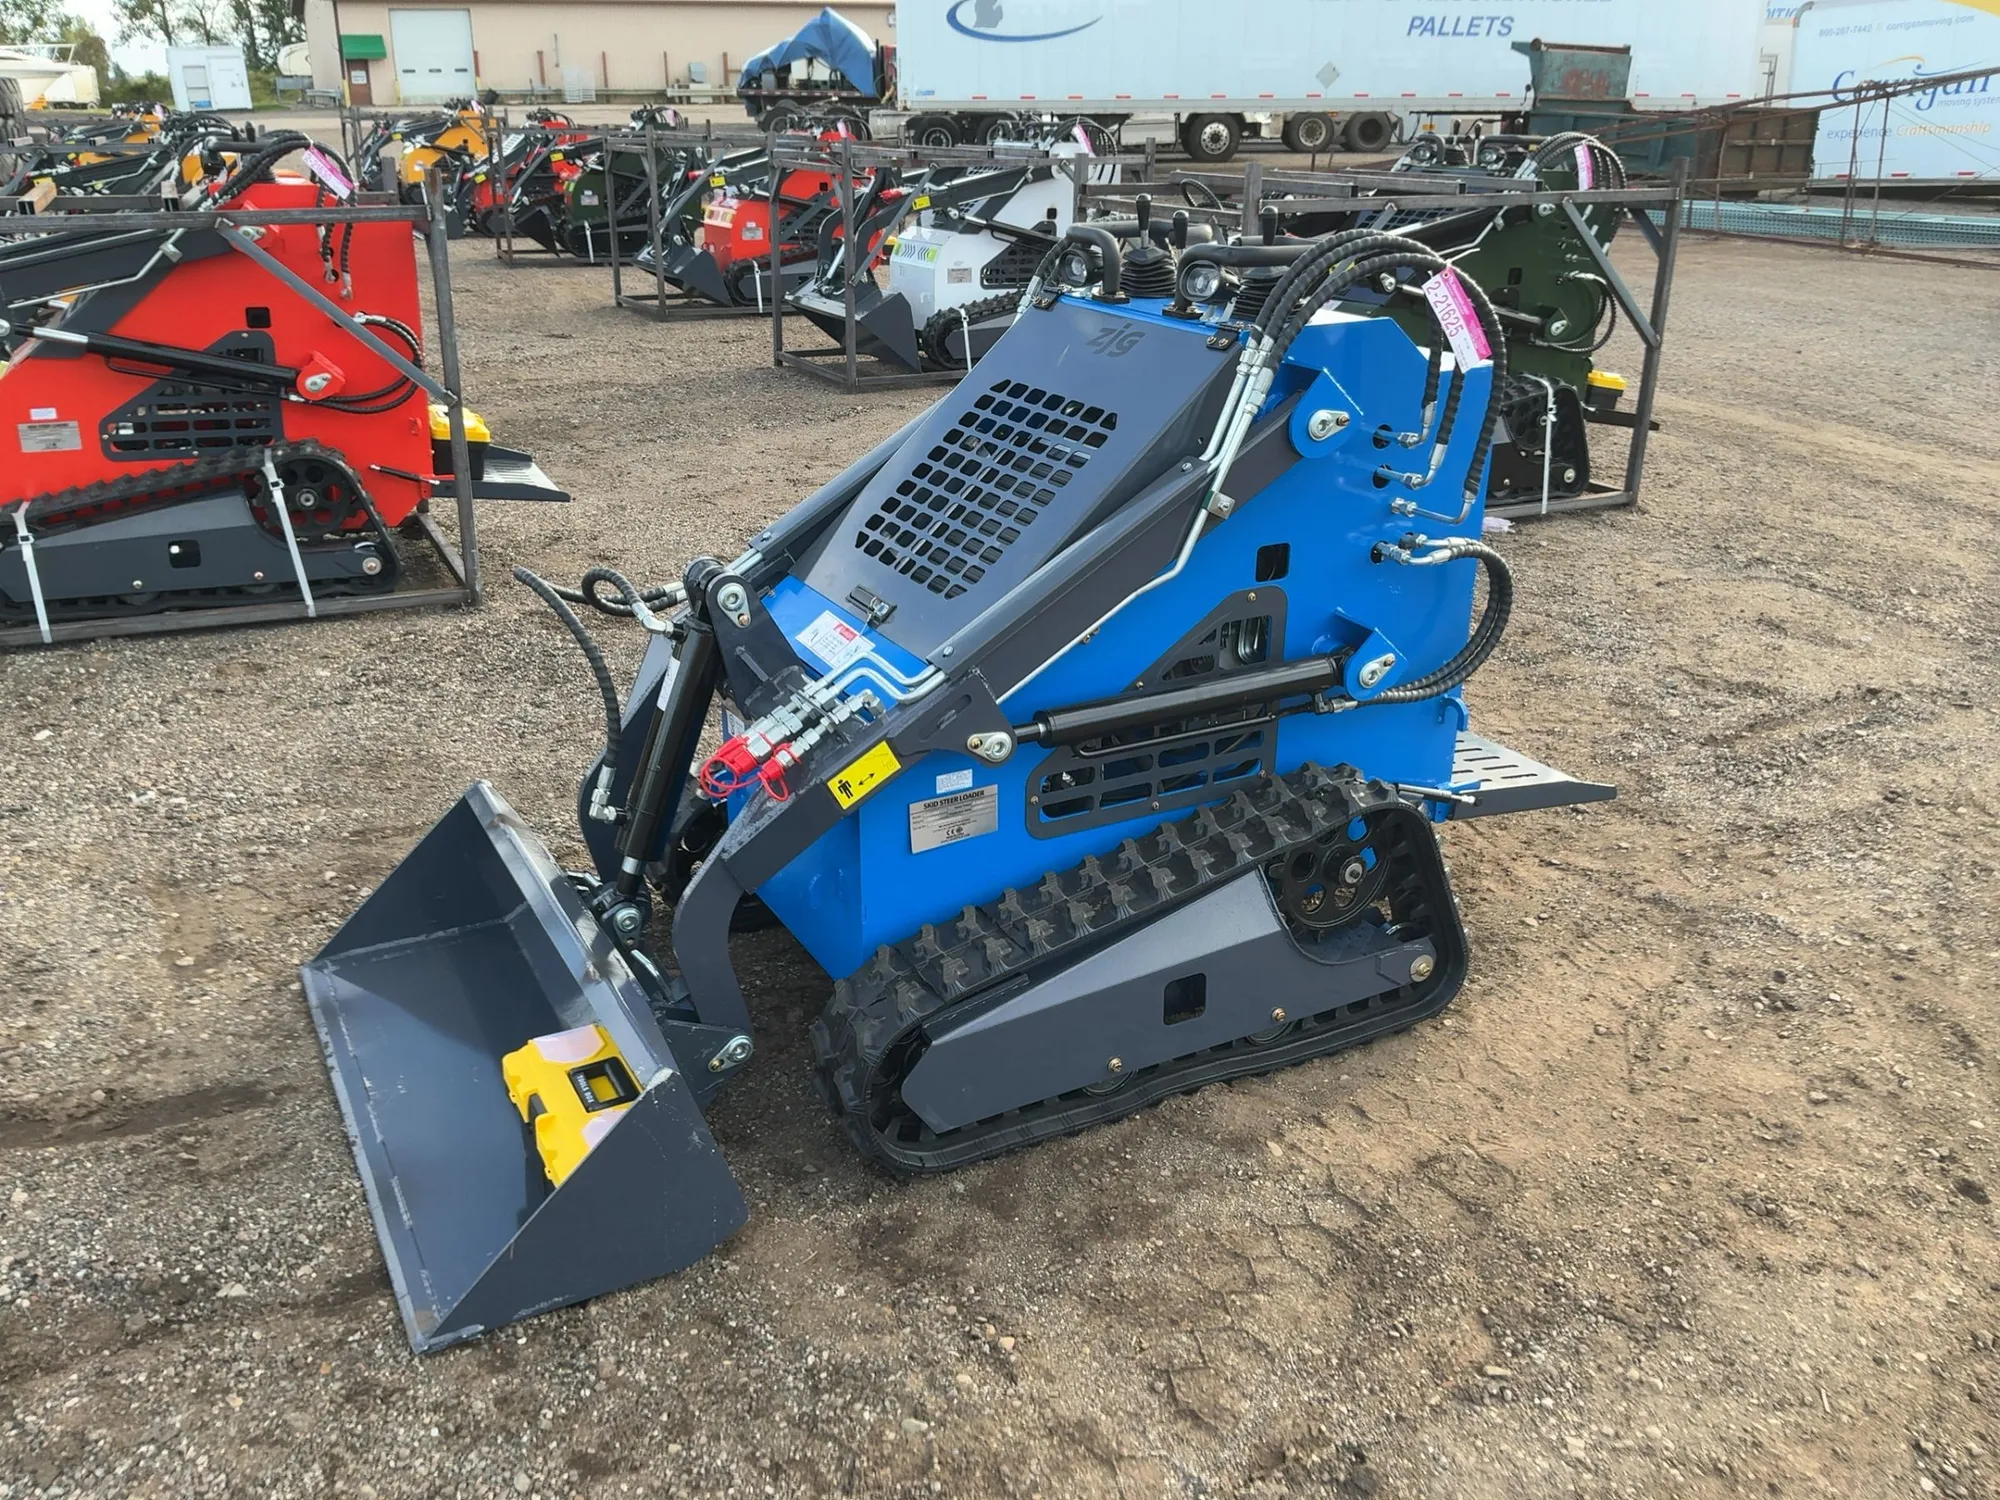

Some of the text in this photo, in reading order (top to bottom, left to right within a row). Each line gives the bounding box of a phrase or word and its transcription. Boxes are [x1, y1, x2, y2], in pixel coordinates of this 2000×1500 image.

[1406, 15, 1515, 37] PALLETS
[1936, 97, 1972, 109] moving
[1826, 120, 1992, 141] experience Craftsmanship
[1425, 280, 1465, 338] 2-21625
[923, 790, 985, 810] SKID STEER LOADER
